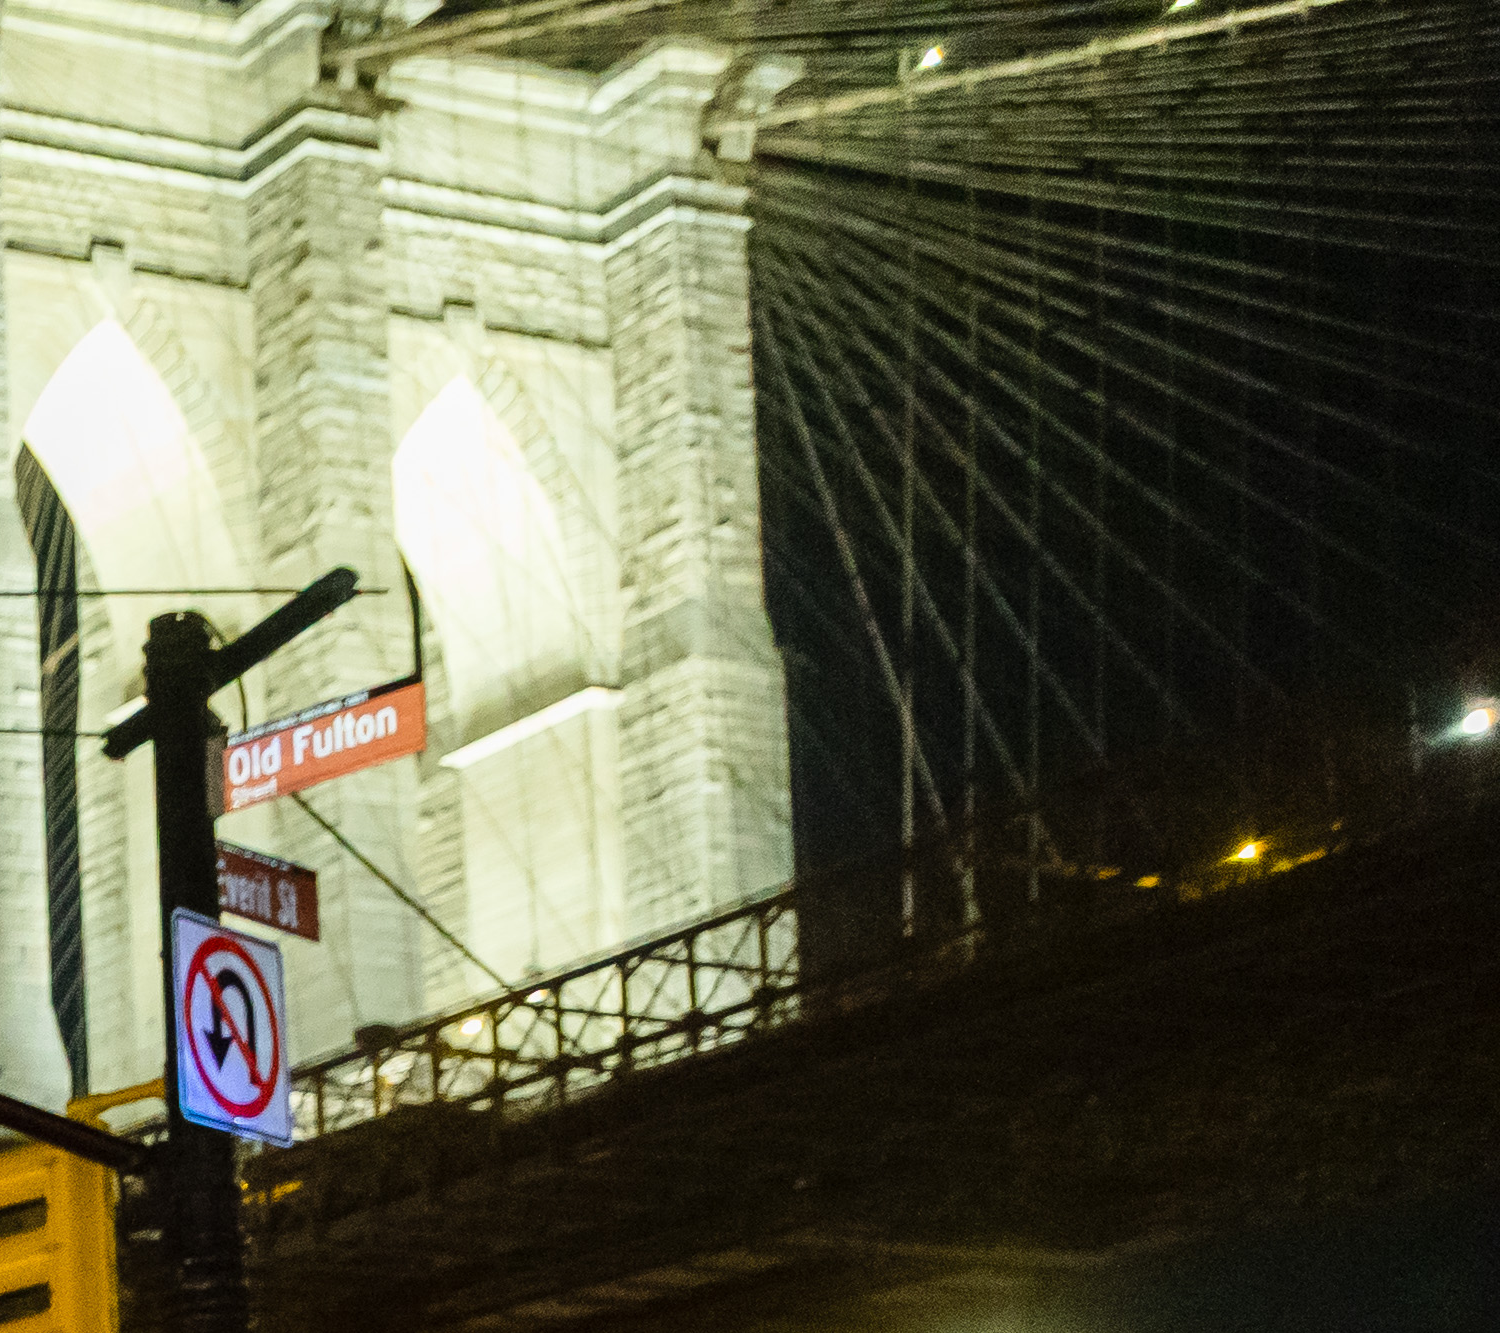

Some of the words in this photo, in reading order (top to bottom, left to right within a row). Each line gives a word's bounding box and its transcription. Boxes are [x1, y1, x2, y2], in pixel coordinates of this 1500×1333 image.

[228, 735, 282, 786] Old
[292, 705, 398, 766] Fulton
[276, 878, 299, 928] St
